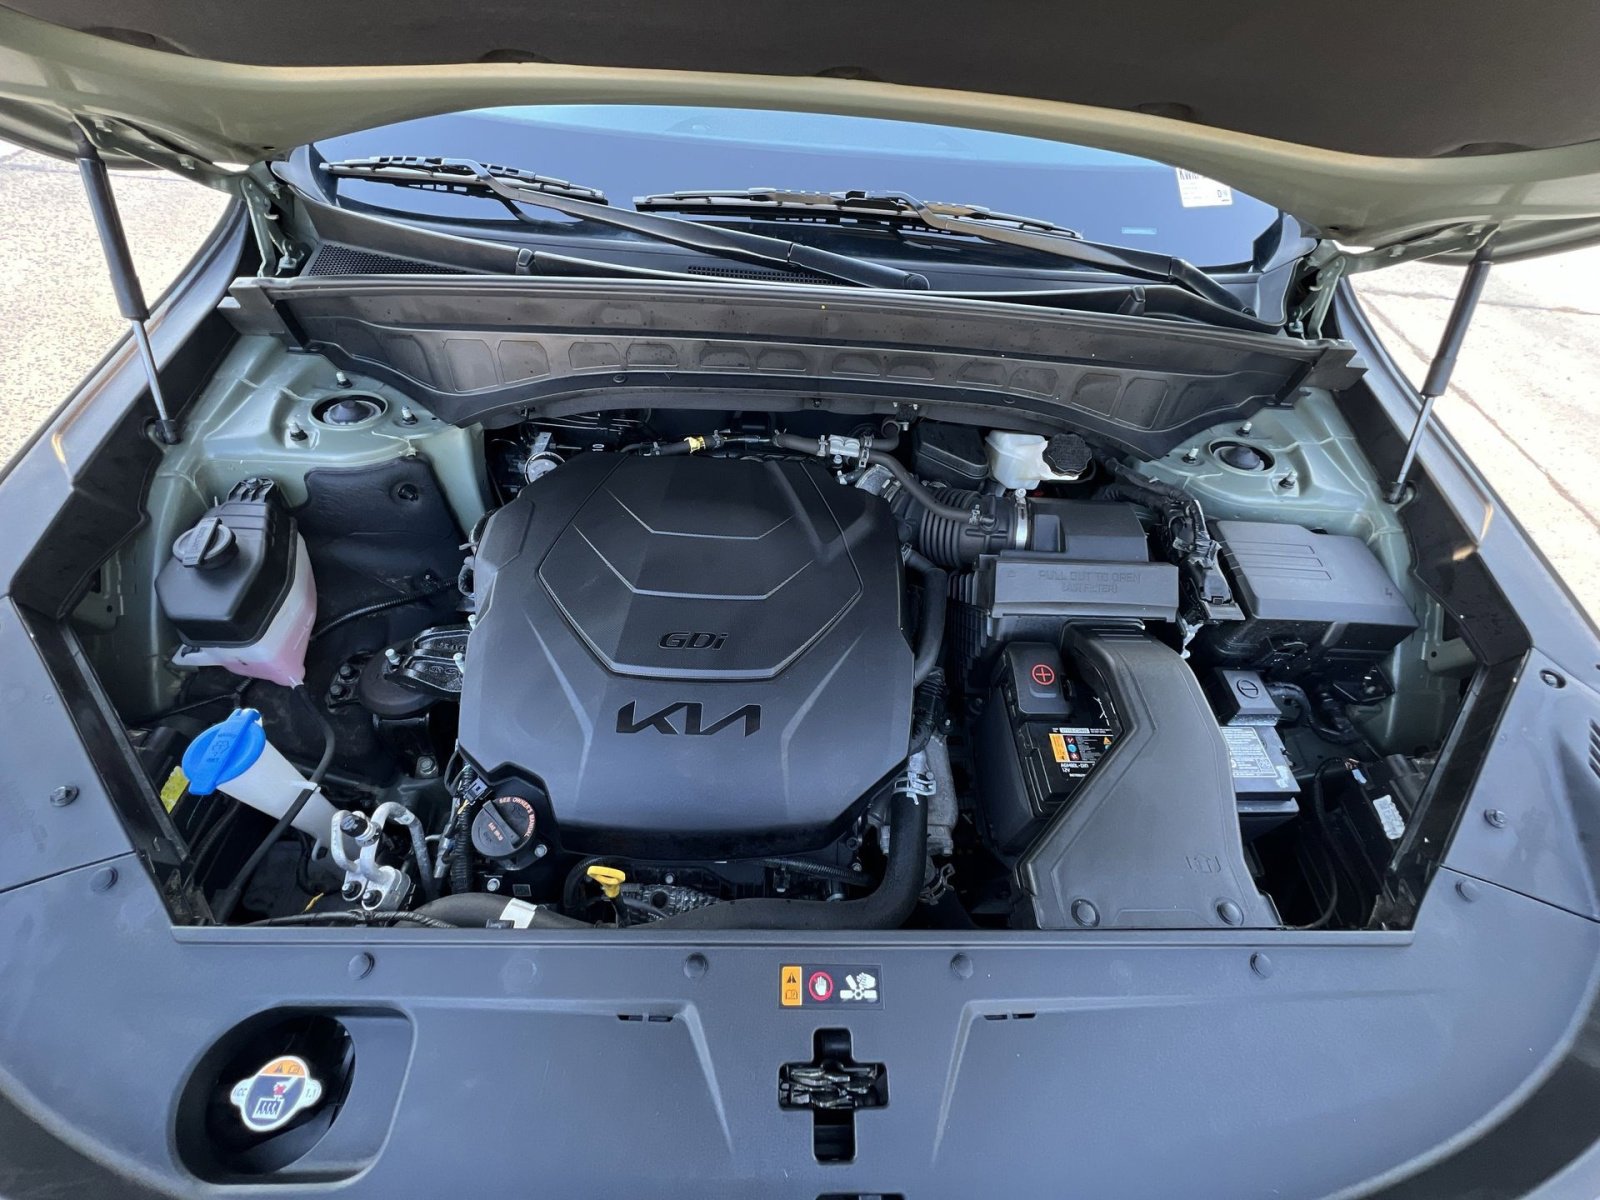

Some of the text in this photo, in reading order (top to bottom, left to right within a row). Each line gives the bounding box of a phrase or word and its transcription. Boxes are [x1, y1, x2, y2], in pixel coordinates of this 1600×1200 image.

[1039, 569, 1141, 584] PULL OUT TO OPEN
[658, 631, 728, 651] GDi
[616, 699, 761, 737] KIA
